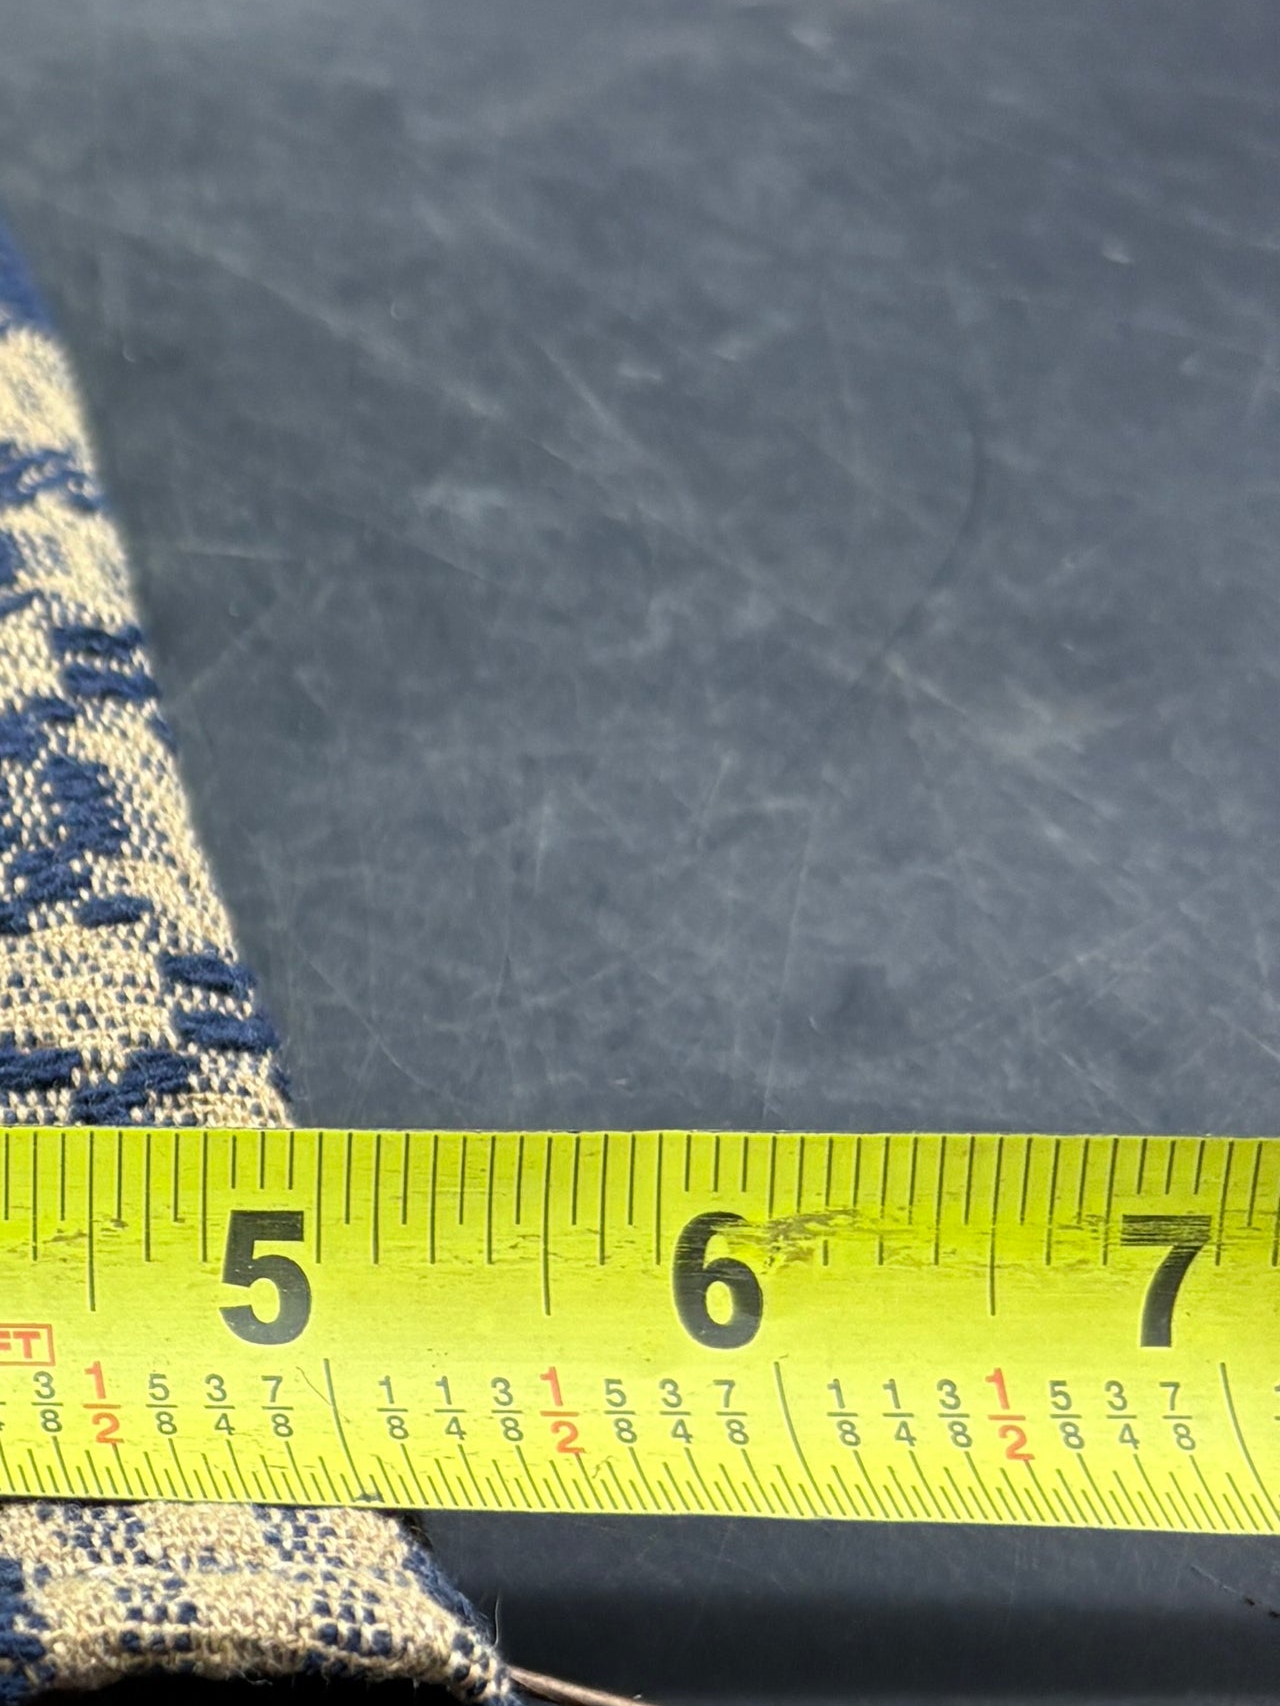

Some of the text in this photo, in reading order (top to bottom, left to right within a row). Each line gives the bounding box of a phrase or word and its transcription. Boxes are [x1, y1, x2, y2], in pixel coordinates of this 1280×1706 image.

[218, 1209, 312, 1346] 5
[672, 1211, 764, 1350] 6
[1120, 1213, 1213, 1348] 7
